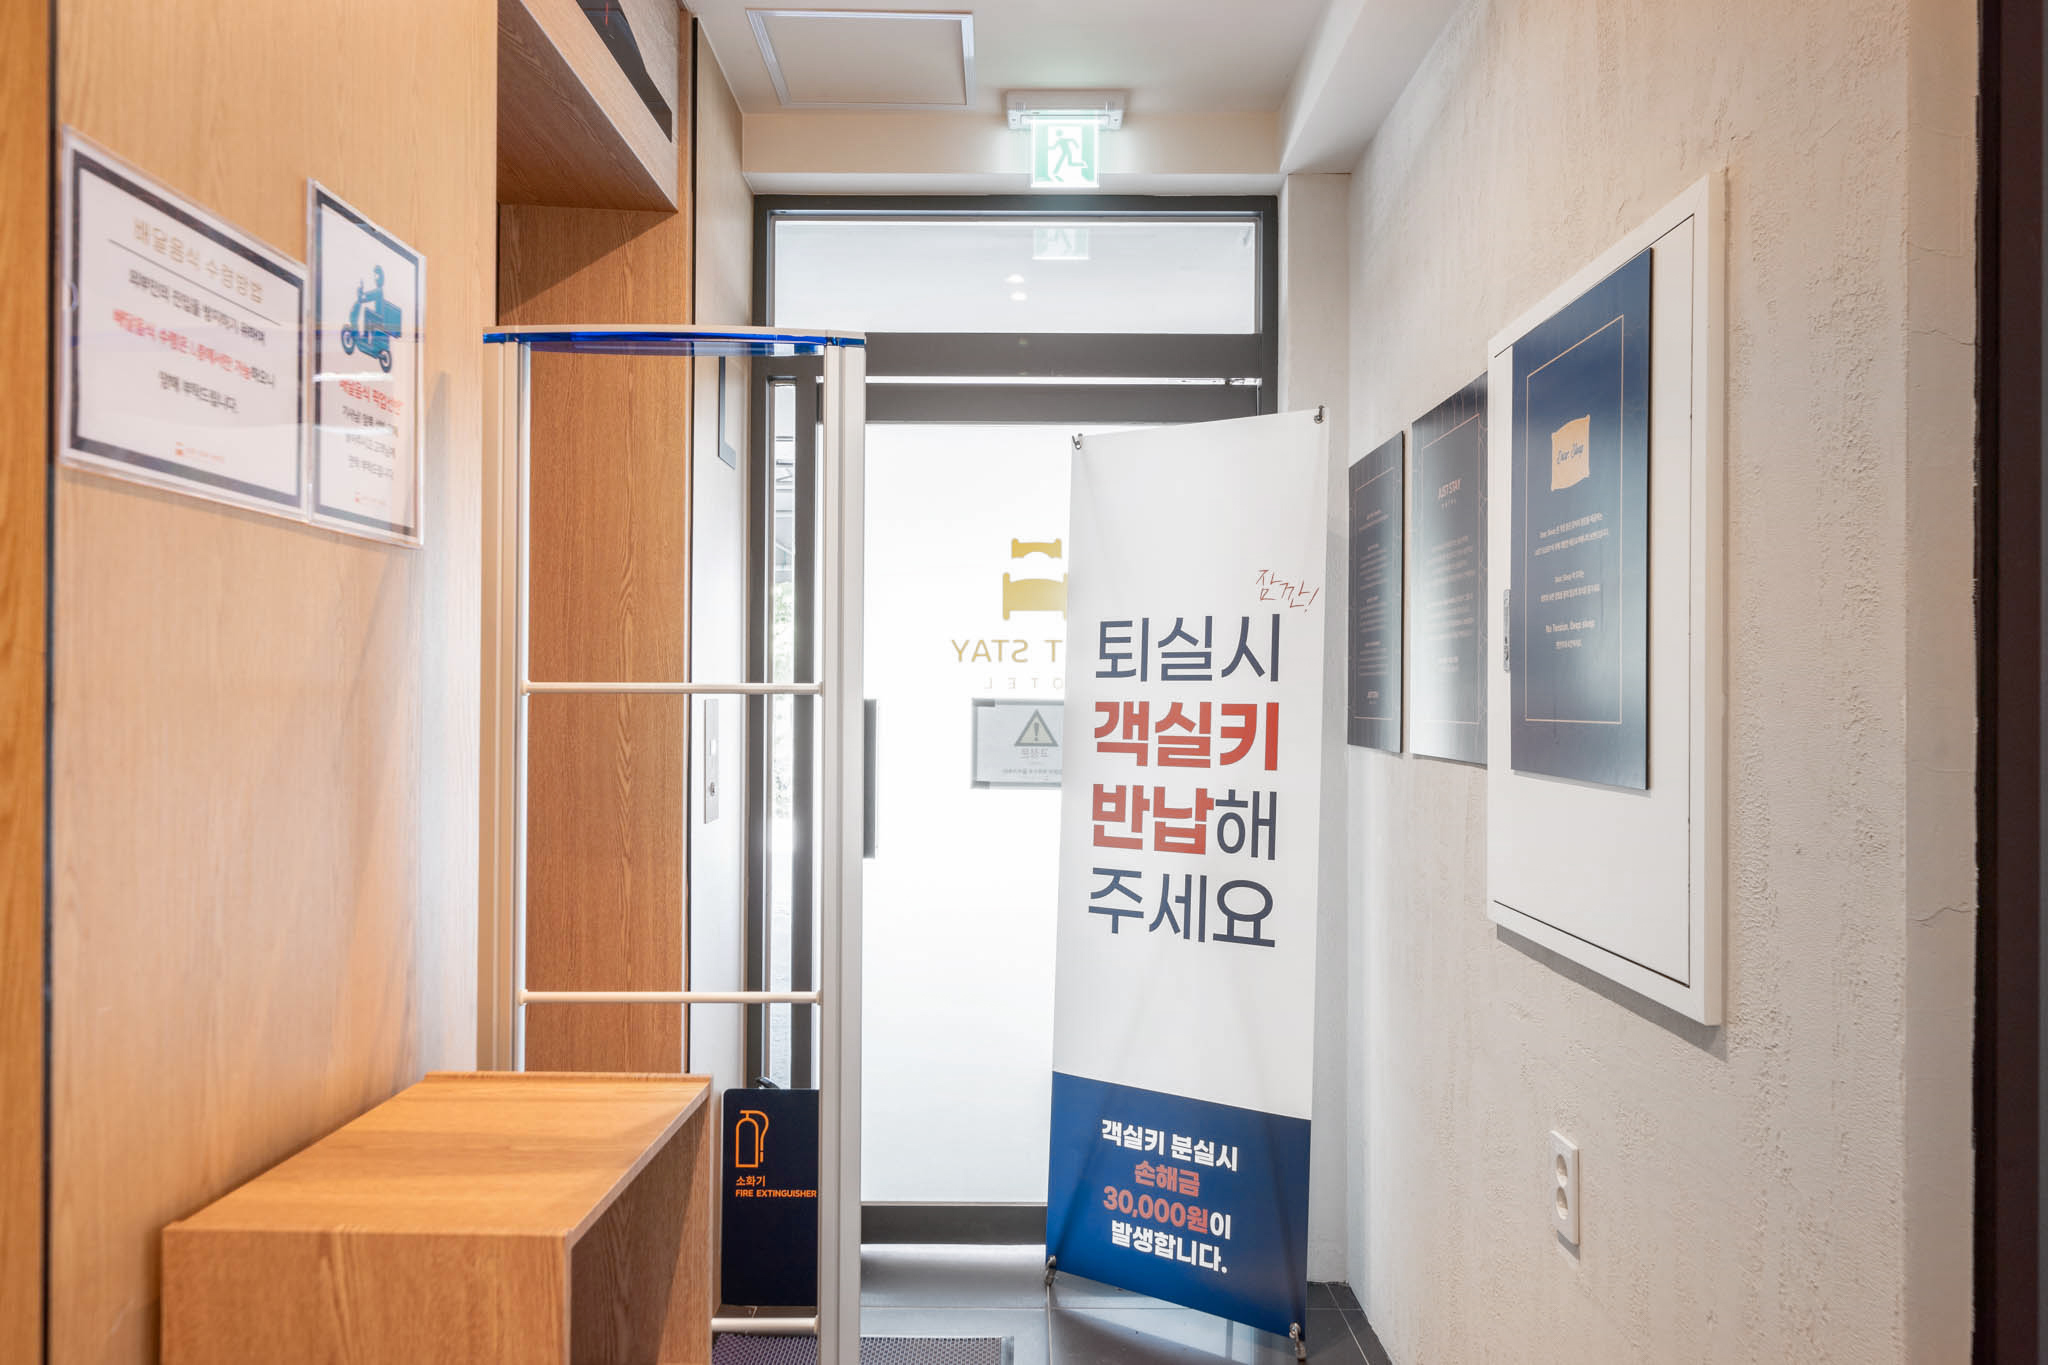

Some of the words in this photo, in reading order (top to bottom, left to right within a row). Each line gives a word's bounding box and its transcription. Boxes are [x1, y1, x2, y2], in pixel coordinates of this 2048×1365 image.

[134, 217, 199, 268] 배달음식
[1255, 569, 1320, 613] 잠깐!
[1095, 613, 1280, 682] 퇴실시
[1094, 701, 1280, 771] 객실키
[1092, 783, 1278, 860] 반납해
[1088, 867, 1276, 948] 주세요
[1102, 1119, 1165, 1155] 객실키
[1170, 1133, 1238, 1172] 분실시
[735, 1175, 766, 1187] 소화기
[735, 1189, 754, 1198] FIRE
[756, 1189, 817, 1198] EXTINGUISHER
[1134, 1160, 1200, 1197] 손해금
[1103, 1185, 1231, 1240] 30,000원이
[1111, 1219, 1228, 1274] 발생합니다.
